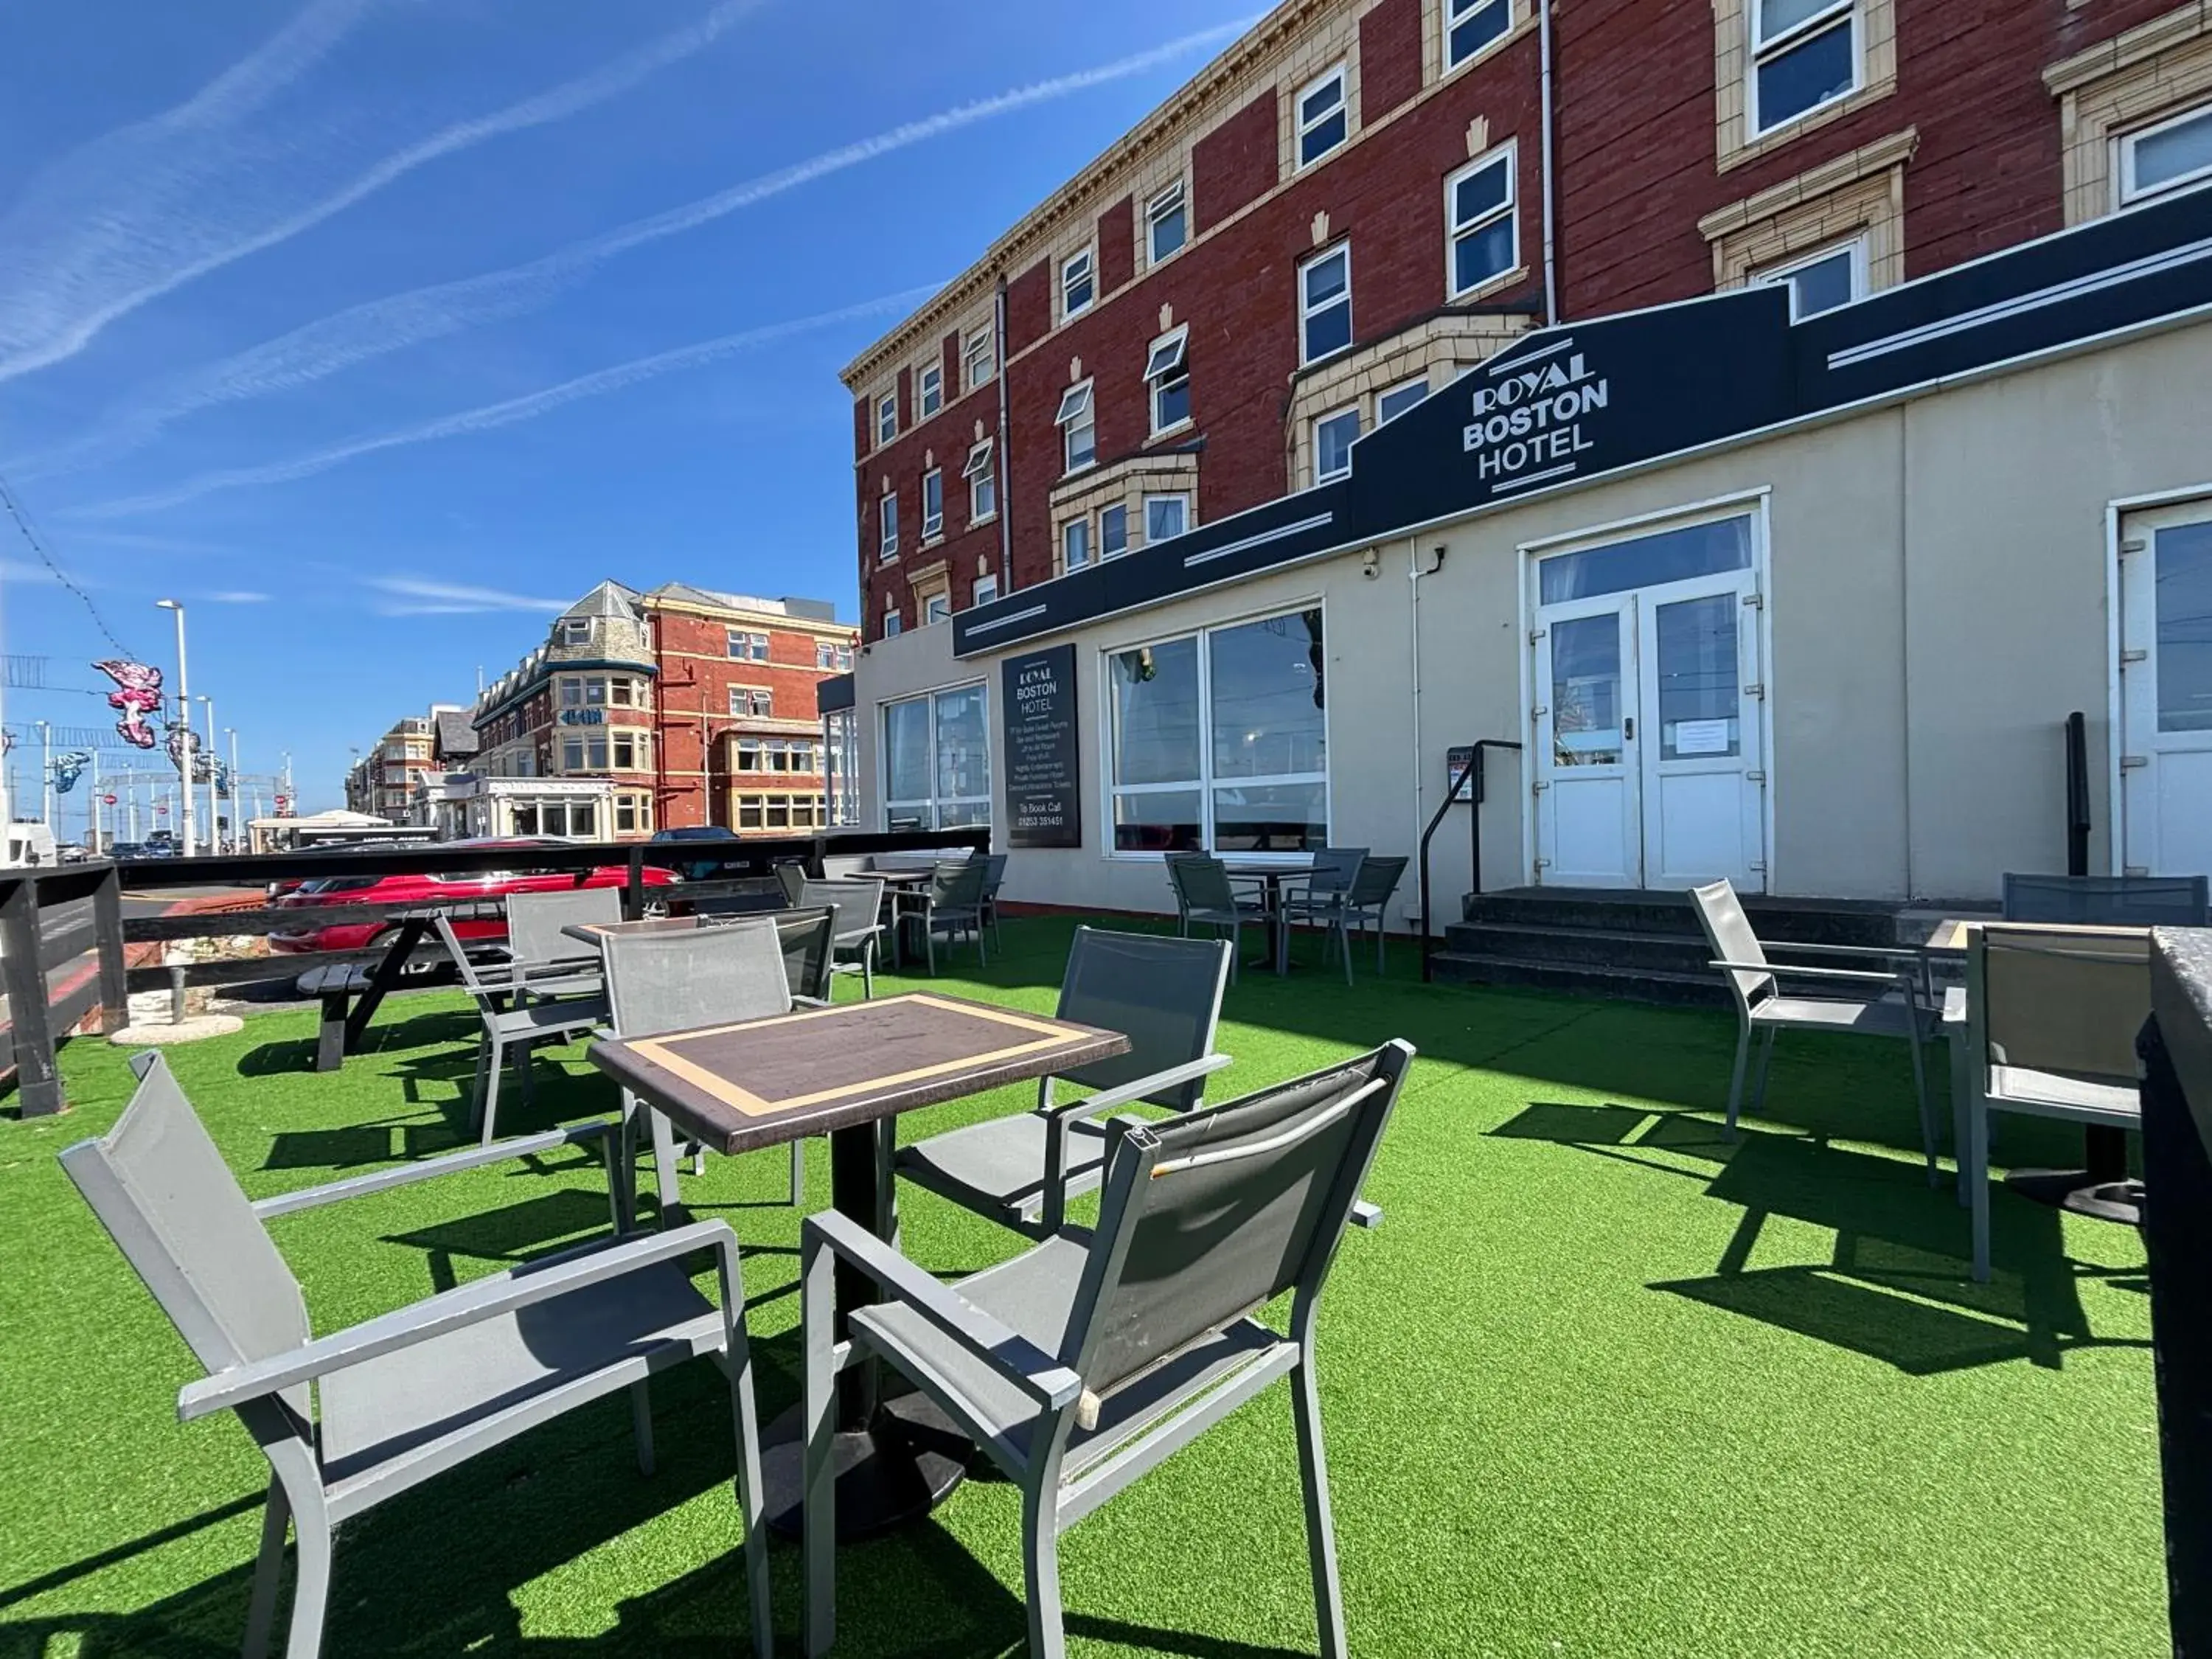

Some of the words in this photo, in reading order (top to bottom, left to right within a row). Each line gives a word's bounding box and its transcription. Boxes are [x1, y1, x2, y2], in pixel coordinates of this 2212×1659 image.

[1472, 353, 1596, 417] ROYAL
[1464, 379, 1608, 452] BOSTON
[1478, 423, 1593, 479] HOTEL
[1020, 667, 1051, 684] ROYAL
[1017, 681, 1057, 700] BOSTON
[1021, 698, 1054, 714] HOTEL
[1029, 802, 1046, 813] Book
[1048, 801, 1062, 812] Call
